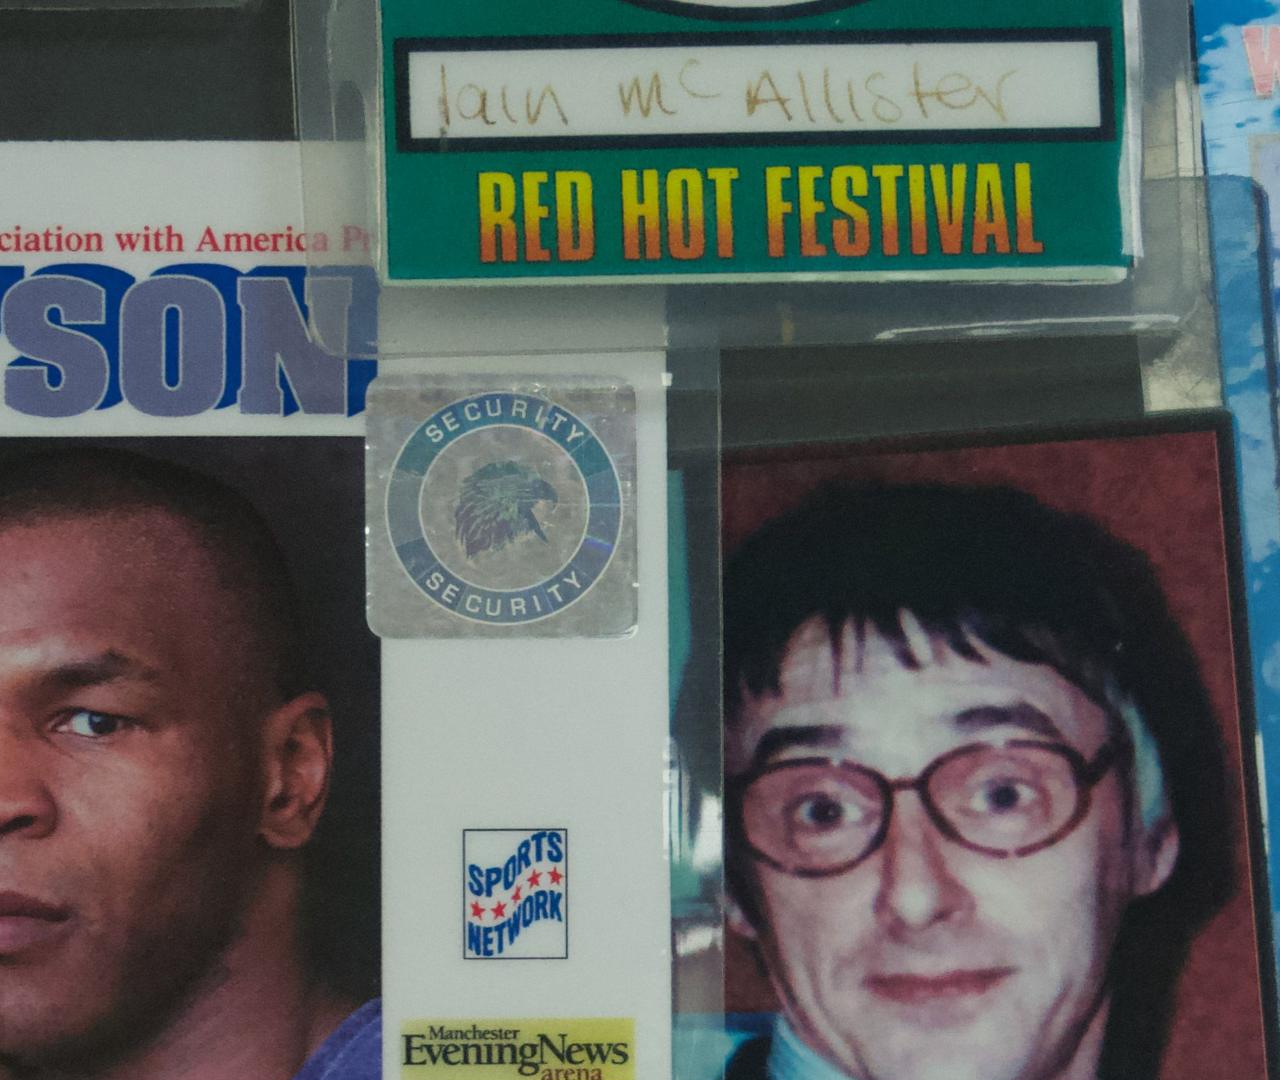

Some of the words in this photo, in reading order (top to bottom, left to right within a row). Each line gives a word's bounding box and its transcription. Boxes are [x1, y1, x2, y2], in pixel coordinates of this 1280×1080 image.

[479, 170, 594, 263] RED
[622, 167, 740, 260] HOT
[766, 163, 1043, 258] FESTIVAL
[115, 226, 184, 253] with
[196, 226, 328, 253] America
[425, 399, 584, 443] SECURITY
[426, 571, 582, 617] SECURITY
[468, 831, 563, 897] SPORTS
[468, 890, 562, 957] NETWORK
[429, 1024, 520, 1041] Manchester
